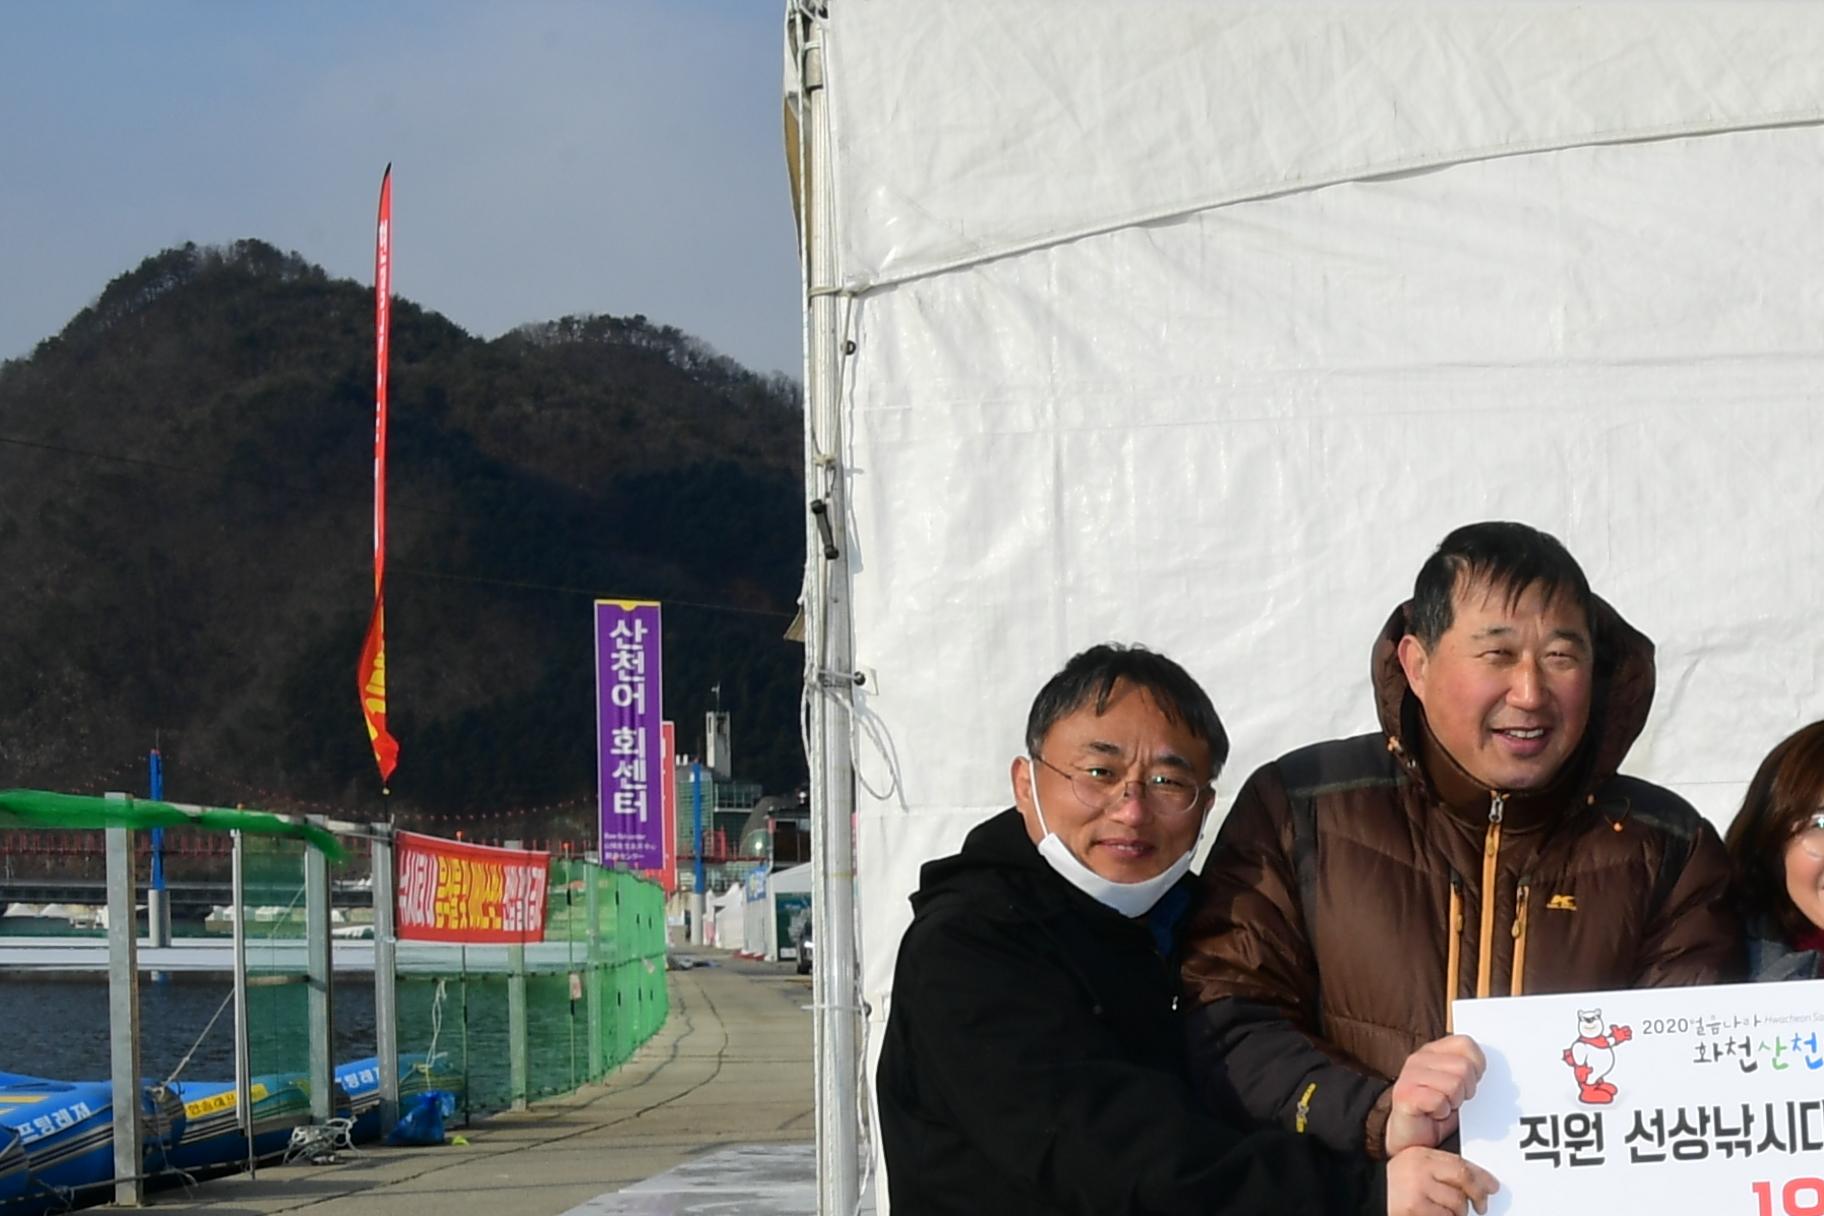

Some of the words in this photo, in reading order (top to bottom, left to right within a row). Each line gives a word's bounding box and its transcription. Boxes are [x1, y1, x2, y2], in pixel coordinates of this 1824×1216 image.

[609, 618, 648, 715] 산천어
[610, 726, 648, 823] 회센터
[1518, 1111, 1605, 1168] 직원
